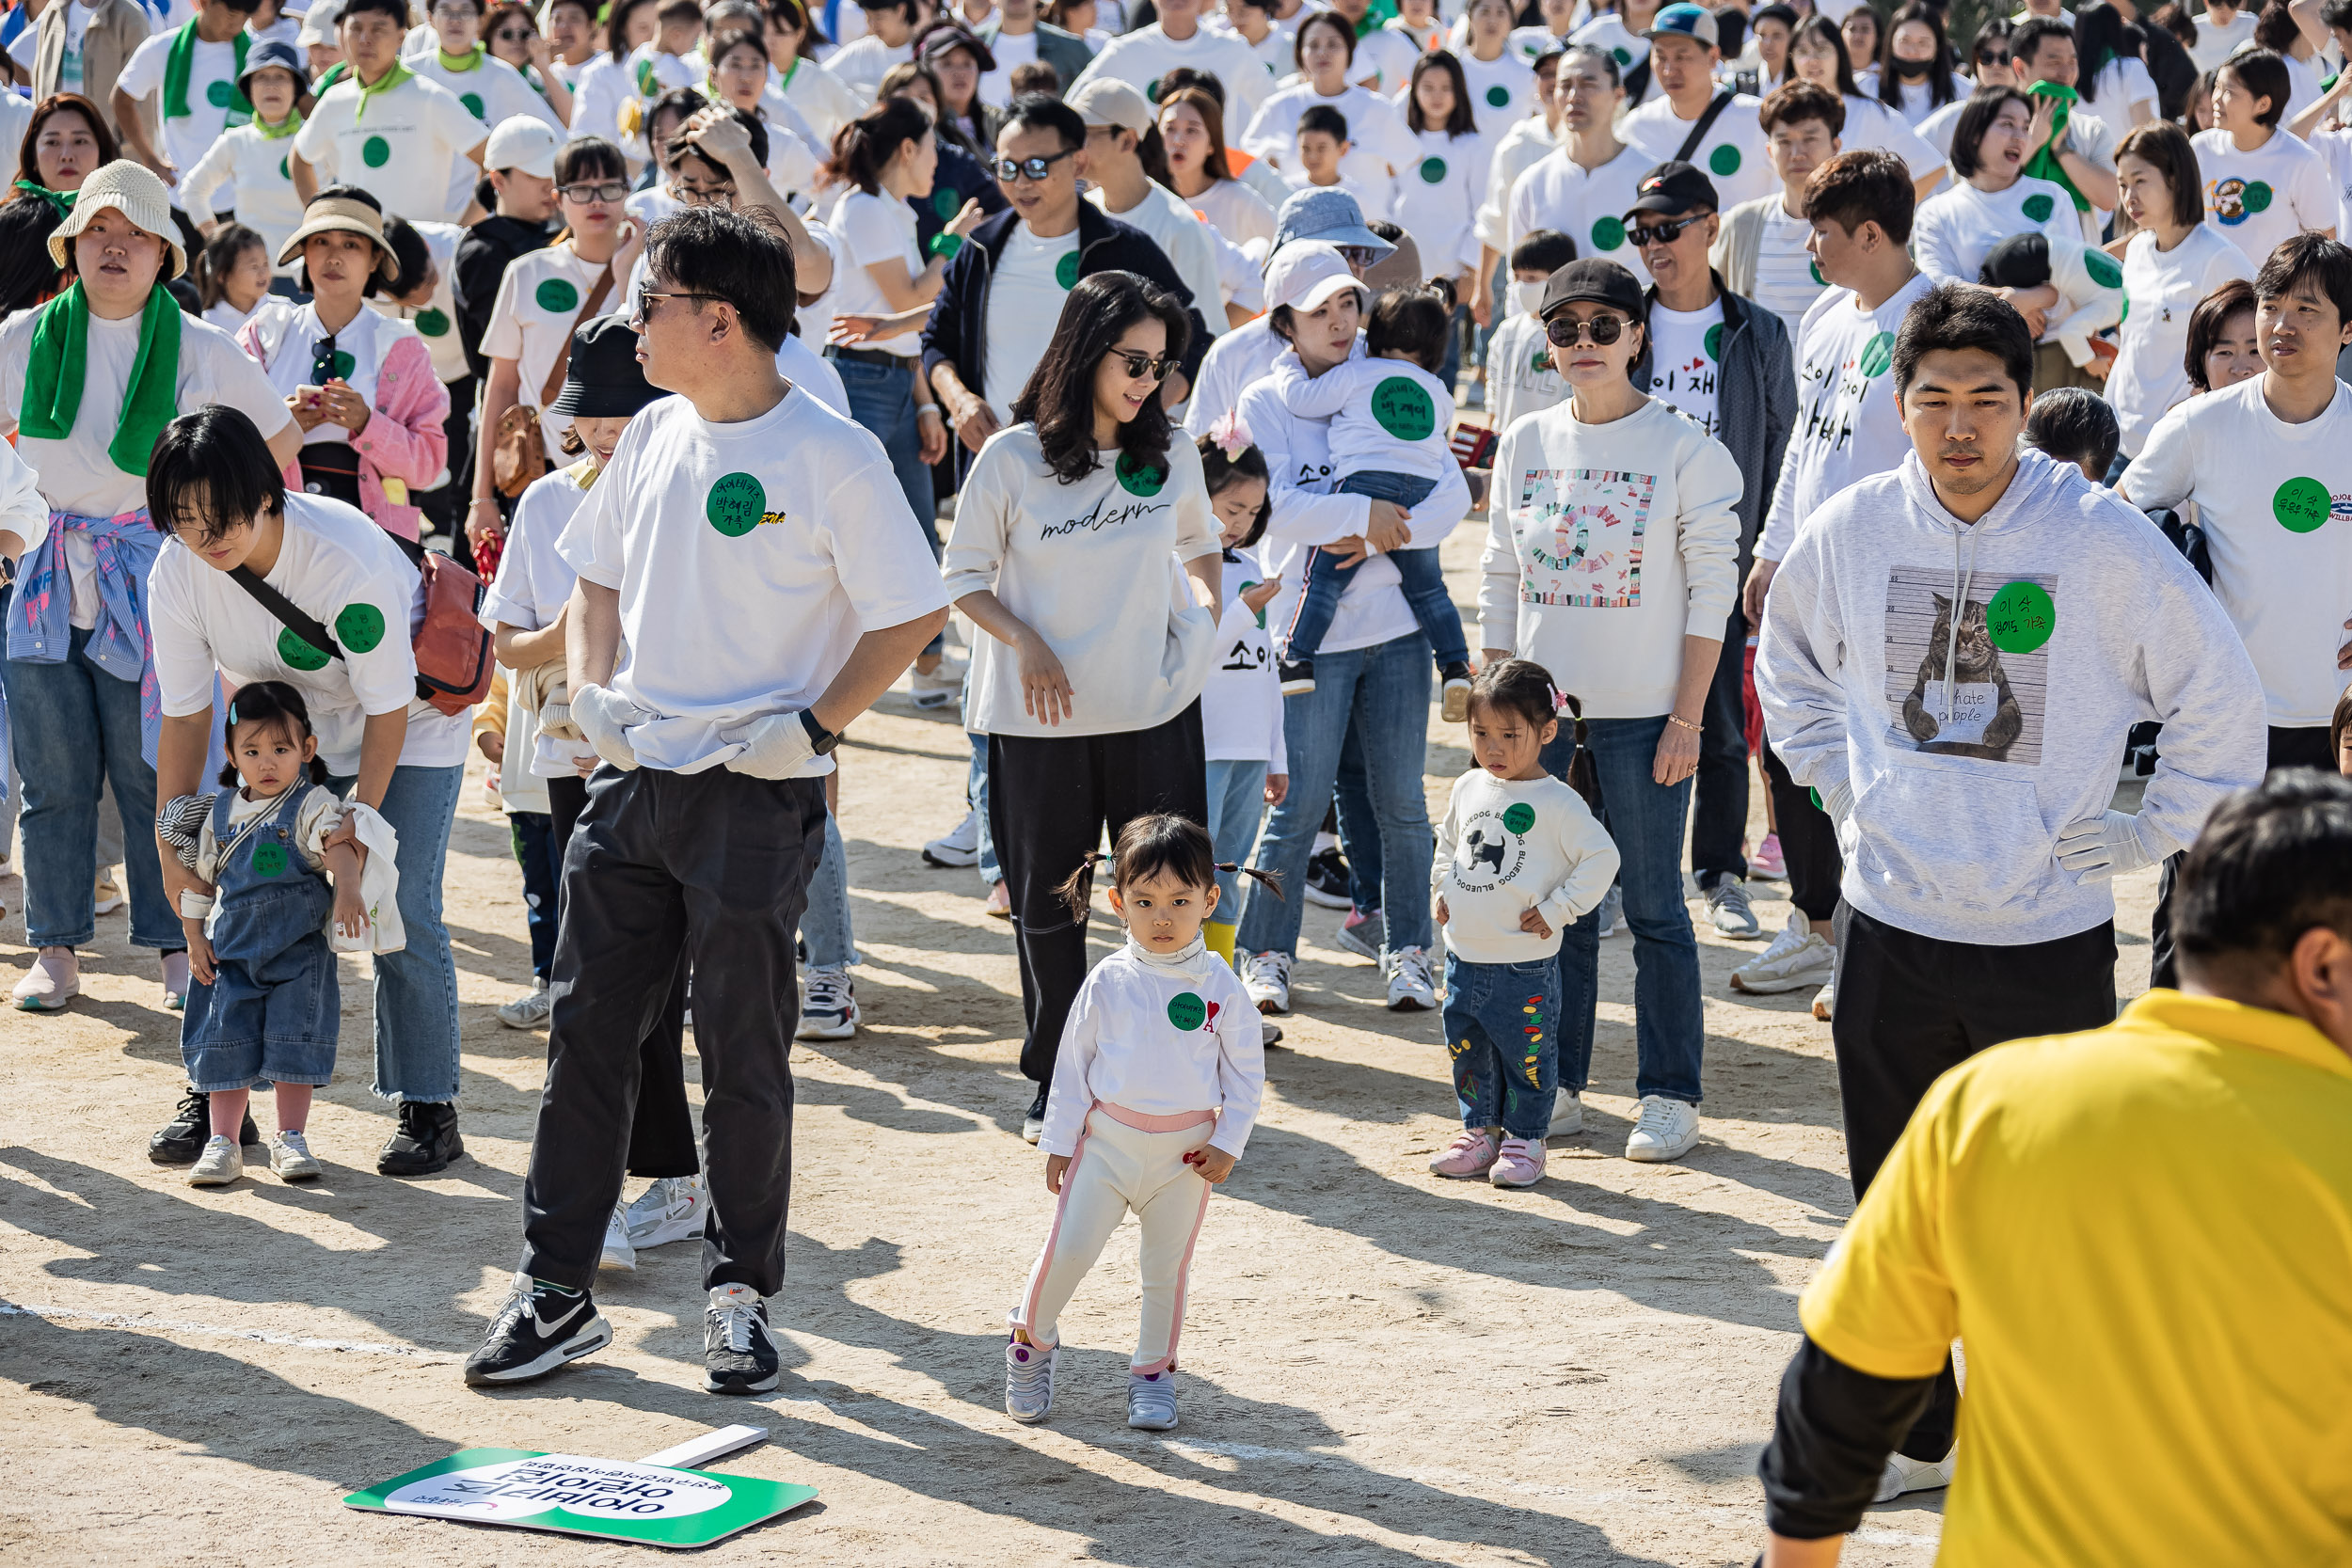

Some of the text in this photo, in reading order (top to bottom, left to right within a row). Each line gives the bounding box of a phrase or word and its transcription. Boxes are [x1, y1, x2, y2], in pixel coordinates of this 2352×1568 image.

[723, 515, 744, 529] 가족
[1040, 497, 1171, 541] modern
[2023, 615, 2047, 630] 가족
[1953, 689, 1986, 705] hate
[1498, 849, 1526, 886] BLUEDOG
[1456, 879, 1495, 894] BLUEDOG
[495, 1467, 673, 1499] 어린이집
[443, 1479, 665, 1514] 아이비키즈
